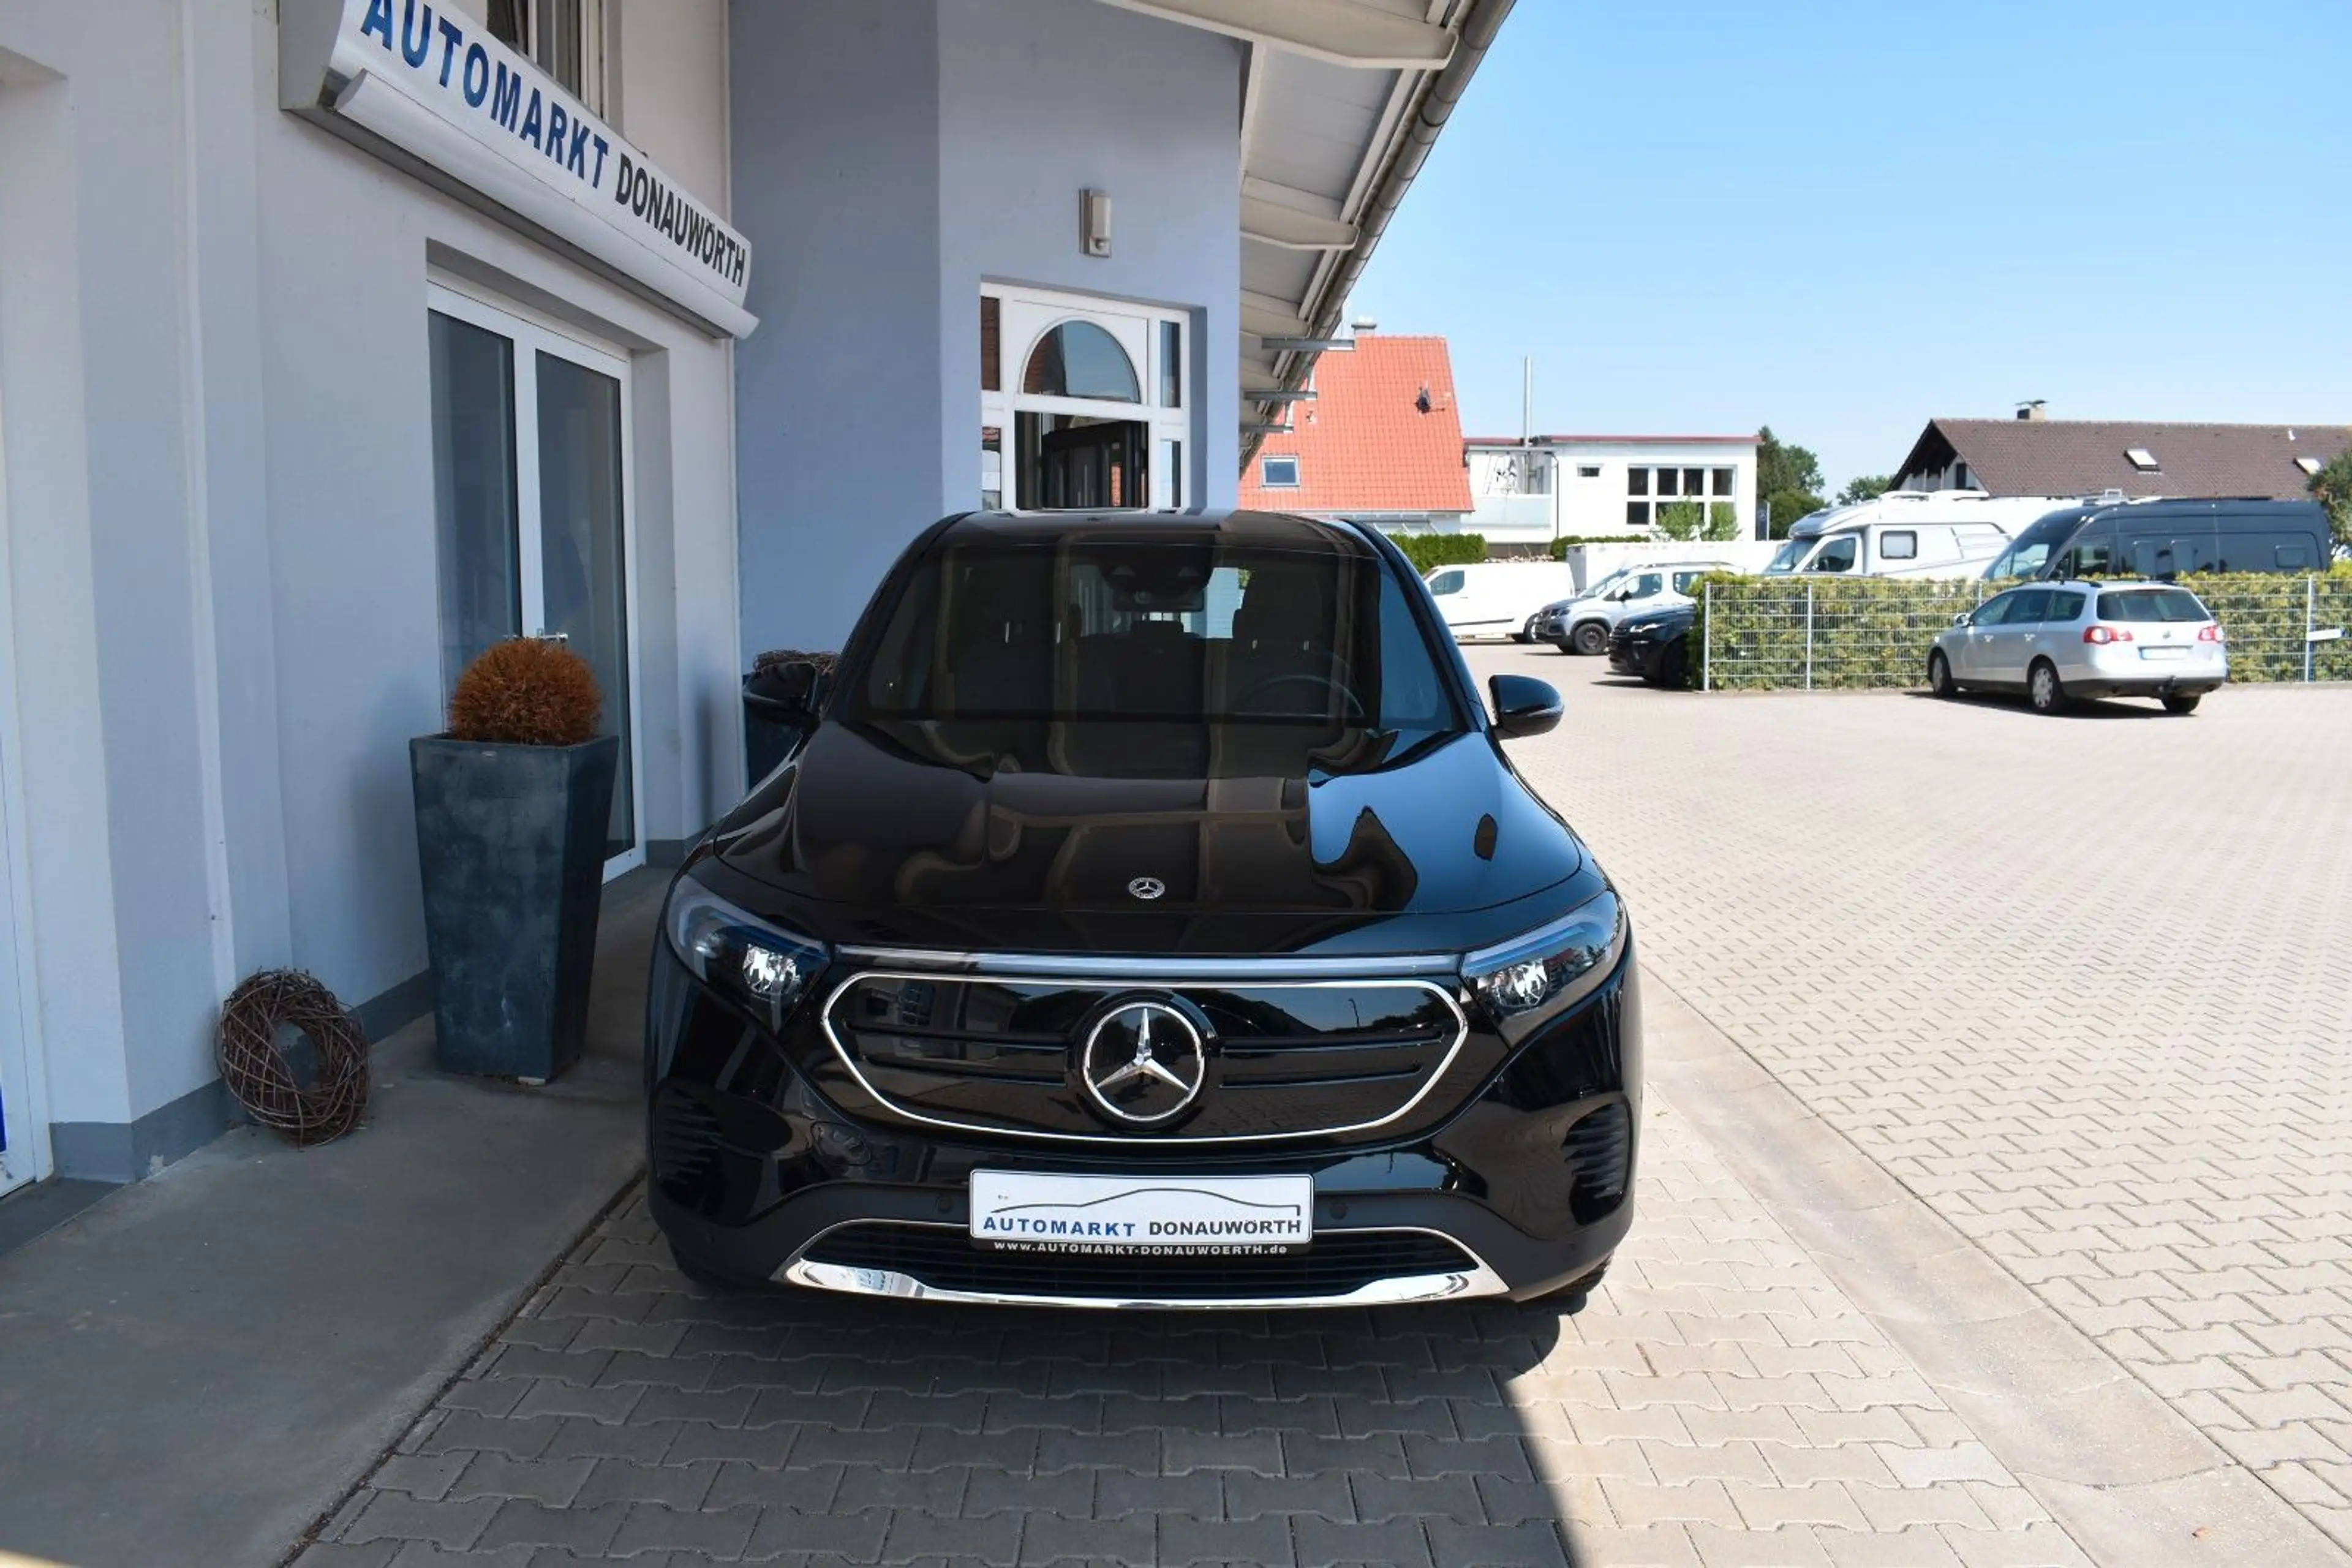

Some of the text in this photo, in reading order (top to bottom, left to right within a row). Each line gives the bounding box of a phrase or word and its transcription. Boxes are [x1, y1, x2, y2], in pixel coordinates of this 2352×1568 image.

[360, 0, 745, 287] AUTOMARKT DONAUWÖRTH
[984, 1217, 1301, 1236] AUTOMARKT DONAUWÖRTH
[994, 1242, 1287, 1255] www.AUTOMARKT-DONAUWOERTH.de
